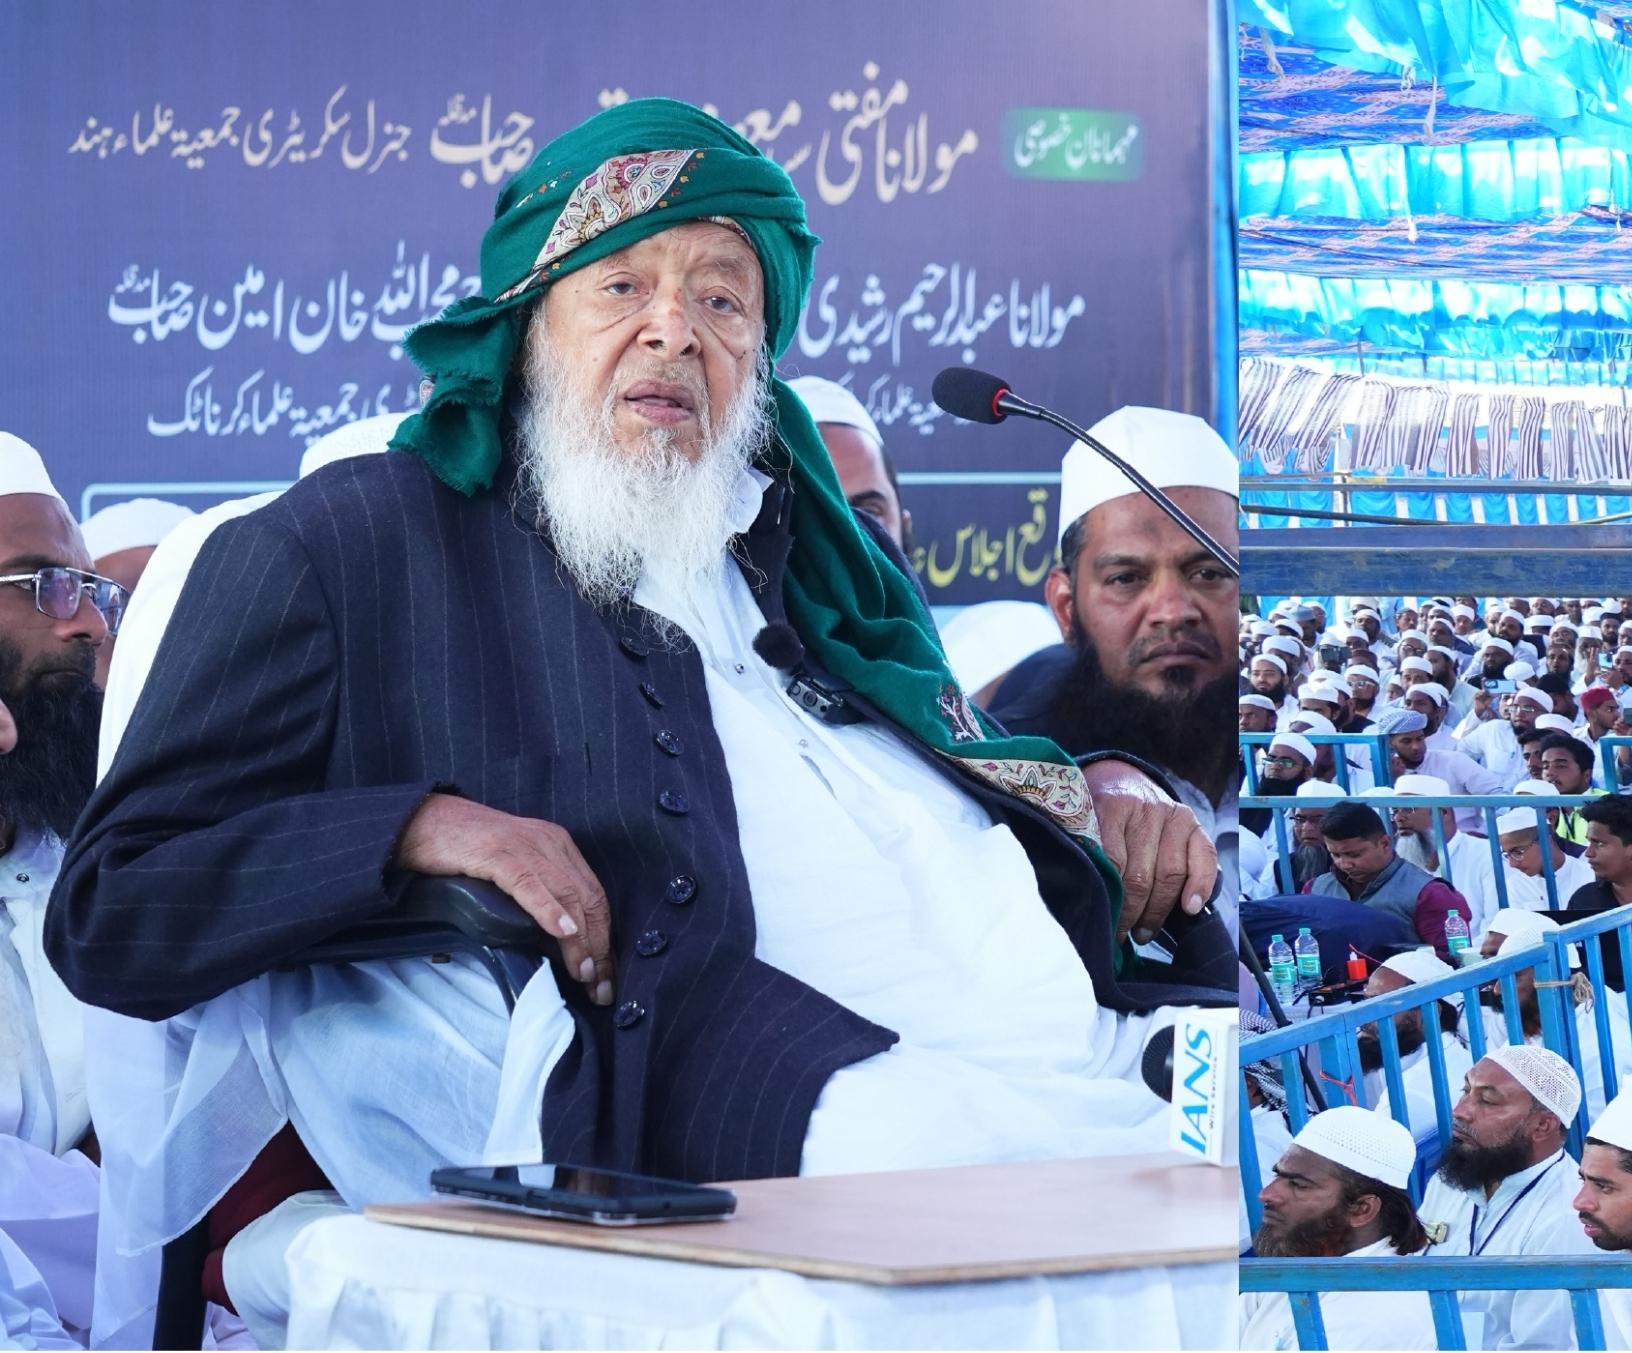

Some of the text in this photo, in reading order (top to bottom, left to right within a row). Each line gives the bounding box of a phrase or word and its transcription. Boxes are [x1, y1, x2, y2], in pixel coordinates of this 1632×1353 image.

[66, 115, 114, 159] ہند
[342, 99, 412, 175] جنرل
[430, 94, 535, 189] صاحب
[815, 60, 909, 206] مفتی
[875, 112, 979, 203] مولانا
[107, 266, 195, 345] صاحب
[197, 263, 285, 350] امین
[288, 269, 370, 355] خان
[1009, 277, 1085, 348] مولانا
[147, 364, 266, 437] کرناٹک
[927, 522, 1016, 589] اجلاس
[1180, 1022, 1212, 1155] IANS
[1208, 1103, 1216, 1129] Wire
